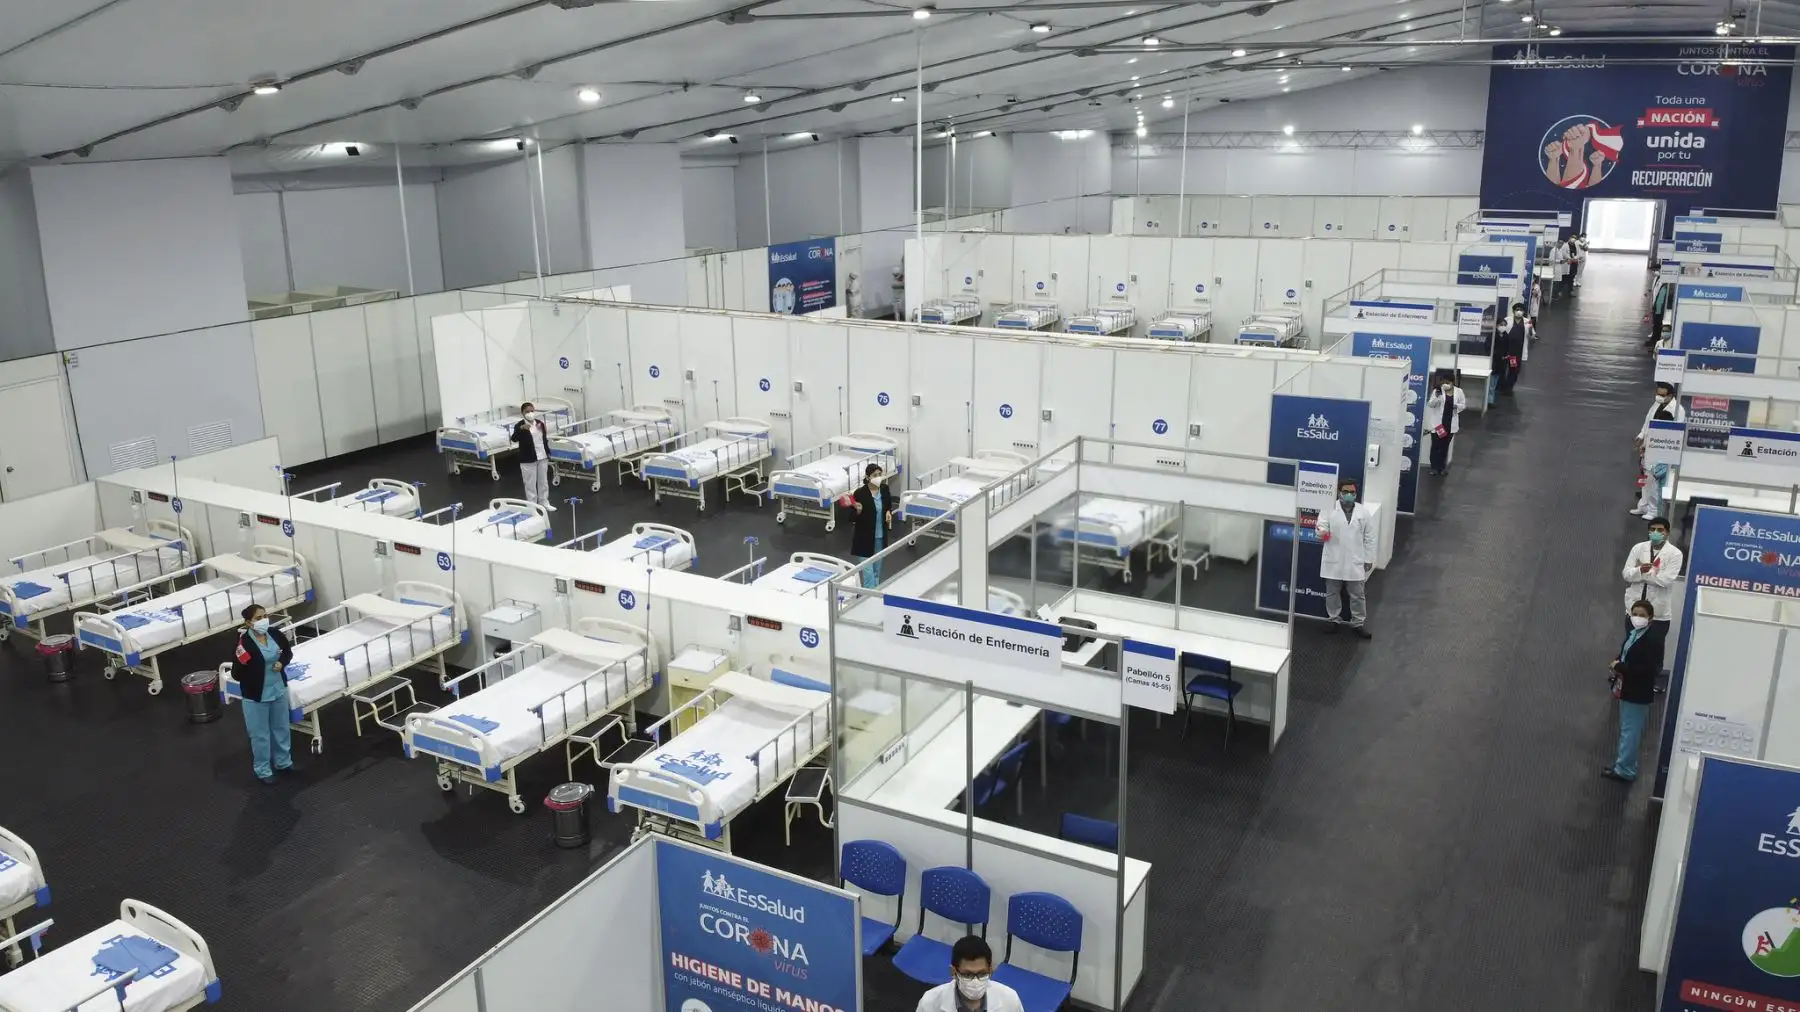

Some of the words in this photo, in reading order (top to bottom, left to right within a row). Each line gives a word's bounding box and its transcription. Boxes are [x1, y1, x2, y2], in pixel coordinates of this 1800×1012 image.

[1679, 47, 1714, 56] JUNTOS
[1656, 95, 1682, 105] Toda
[1684, 97, 1706, 105] una
[1651, 110, 1706, 124] NACIÓN
[1646, 130, 1706, 148] unida
[1658, 152, 1676, 162] por
[1678, 151, 1690, 160] tu
[1632, 168, 1712, 188] RECUPERACIÓN
[1385, 341, 1412, 350] EsSalud
[559, 359, 568, 368] 72
[650, 368, 659, 376] 73
[760, 381, 770, 390] 74
[878, 395, 888, 404] 75
[1001, 407, 1011, 416] 76
[1154, 422, 1166, 432] 77
[1297, 428, 1339, 441] EsSalud
[1757, 446, 1797, 457] Estación
[1302, 481, 1327, 489] Pabellón
[1757, 528, 1800, 543] EsSalu
[438, 556, 450, 567] 53
[1695, 574, 1749, 590] HIGIENE
[1753, 582, 1770, 593] DE
[620, 593, 634, 605] 54
[801, 630, 816, 644] 55
[918, 623, 966, 642] Estación
[969, 631, 983, 645] de
[986, 636, 1050, 659] Enfermería
[1127, 666, 1162, 680] Pabellón
[1165, 673, 1170, 682] 5
[1125, 677, 1149, 690] (Camas
[700, 903, 719, 914] JUNTOS
[719, 909, 742, 920] CONTRA
[737, 888, 804, 923] EsSalud
[672, 952, 742, 988] HIGIENE
[747, 978, 770, 998] DE
[774, 960, 808, 980] virus
[674, 974, 687, 983] con
[690, 975, 711, 993] jabón
[713, 985, 756, 1007] antiséptico
[1691, 987, 1757, 1008] NINGÚN
